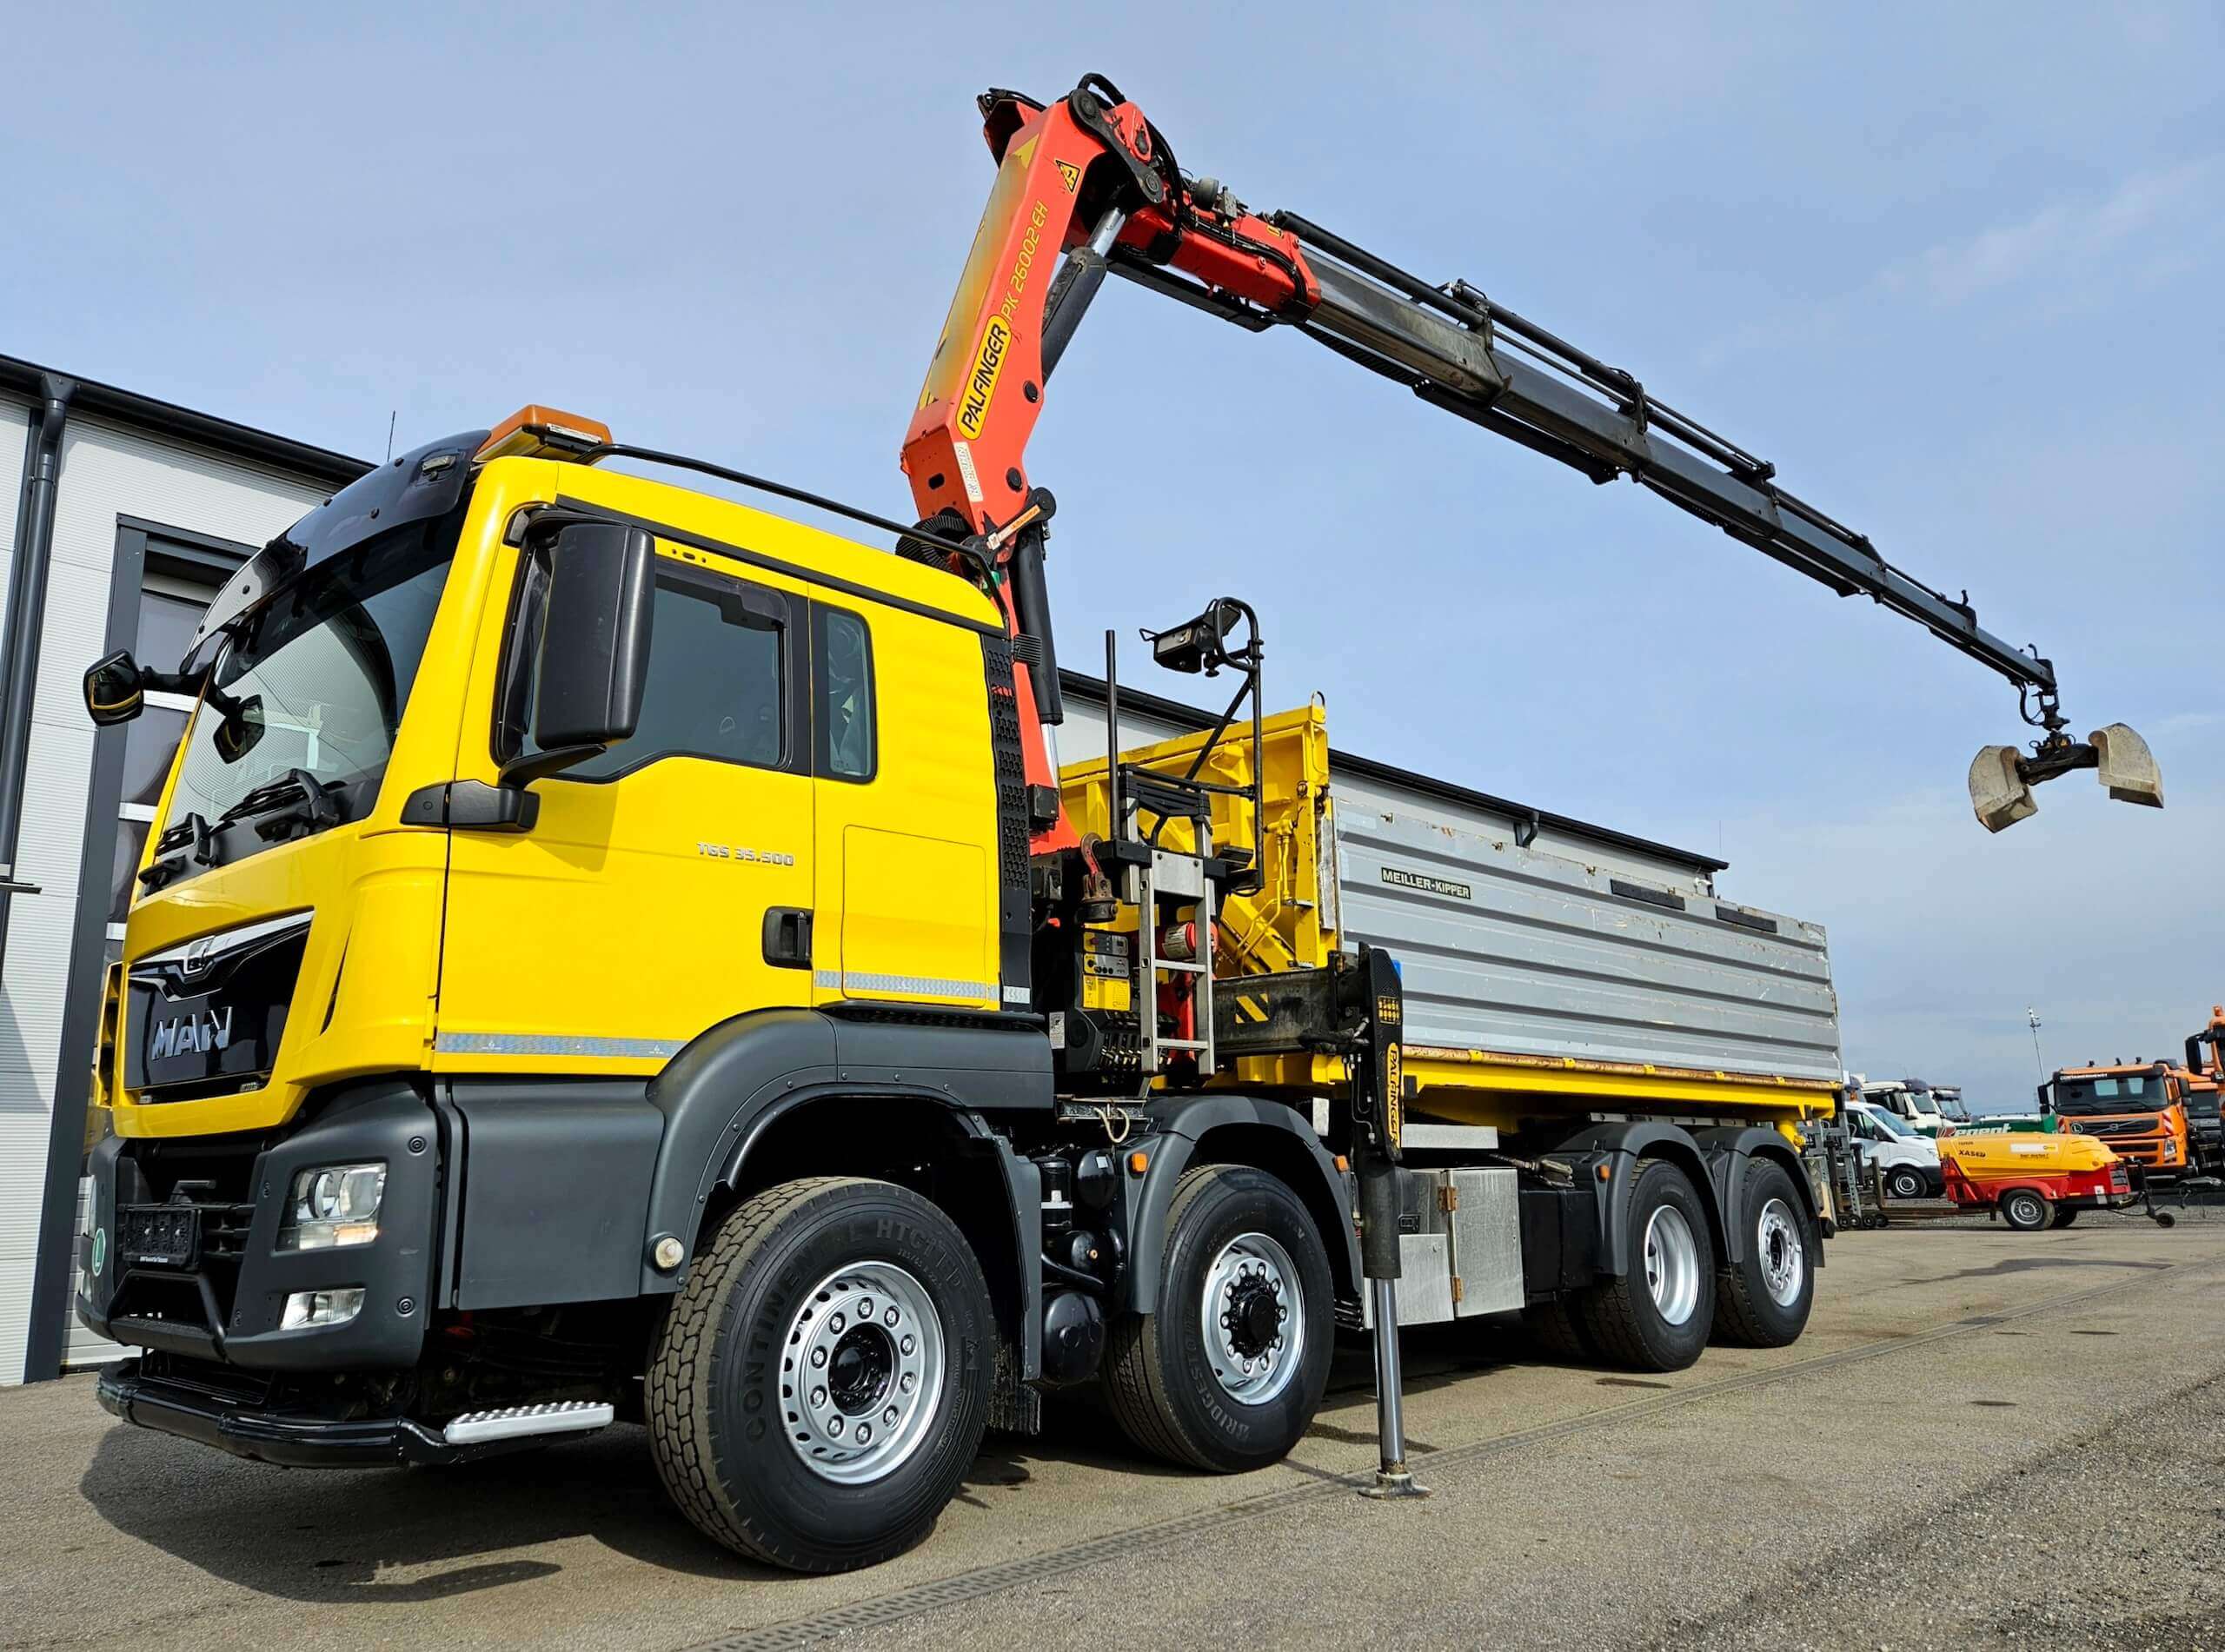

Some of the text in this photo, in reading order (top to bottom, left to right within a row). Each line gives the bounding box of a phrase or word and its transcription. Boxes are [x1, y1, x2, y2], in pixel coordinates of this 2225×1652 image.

[1000, 291, 1019, 322] PK
[961, 323, 1007, 433] PALFINGER
[696, 842, 794, 866] TGS 35.500
[1383, 870, 1469, 898] MEILLER-KIPPER
[151, 1006, 232, 1059] MAN
[1390, 1048, 1400, 1145] PALFINGER
